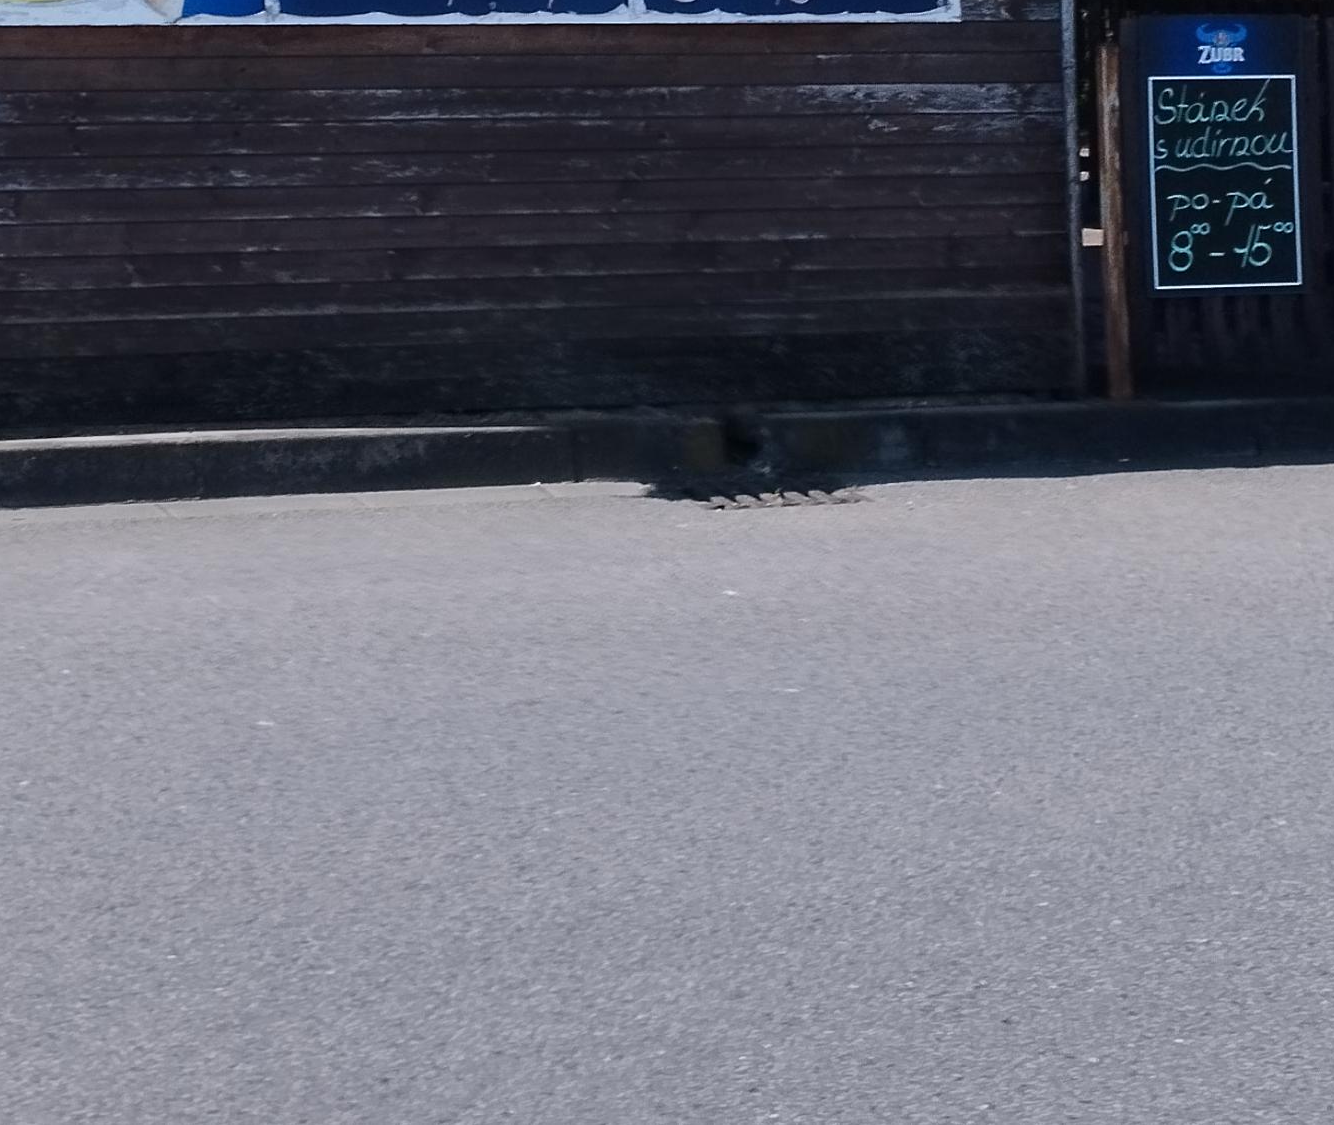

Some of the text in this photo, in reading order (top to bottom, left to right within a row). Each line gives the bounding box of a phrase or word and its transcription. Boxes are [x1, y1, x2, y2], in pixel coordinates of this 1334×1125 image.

[1197, 45, 1246, 64] ZUBR
[1154, 78, 1270, 125] Stánek
[1153, 138, 1168, 160] s
